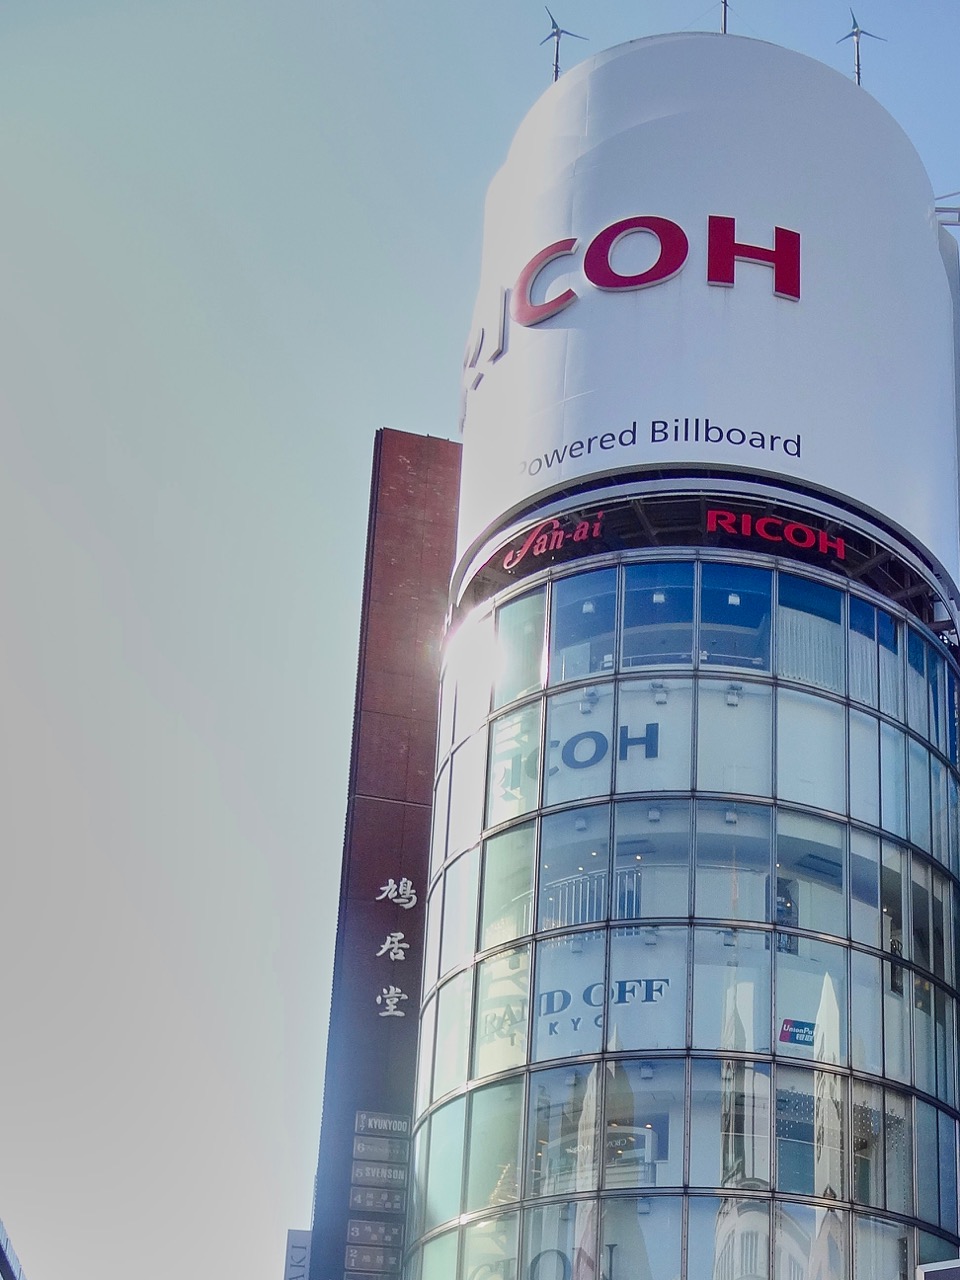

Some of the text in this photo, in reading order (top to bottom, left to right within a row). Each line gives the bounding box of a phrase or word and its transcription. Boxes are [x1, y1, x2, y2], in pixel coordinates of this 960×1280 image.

[650, 418, 802, 458] Billboard
[706, 508, 846, 560] RICOH
[375, 876, 419, 1018] 鳩居堂
[583, 978, 670, 1008] OFF
[783, 1024, 815, 1035] UnionPa
[368, 1118, 408, 1132] KYUKYODO
[365, 1166, 405, 1180] SVENSON
